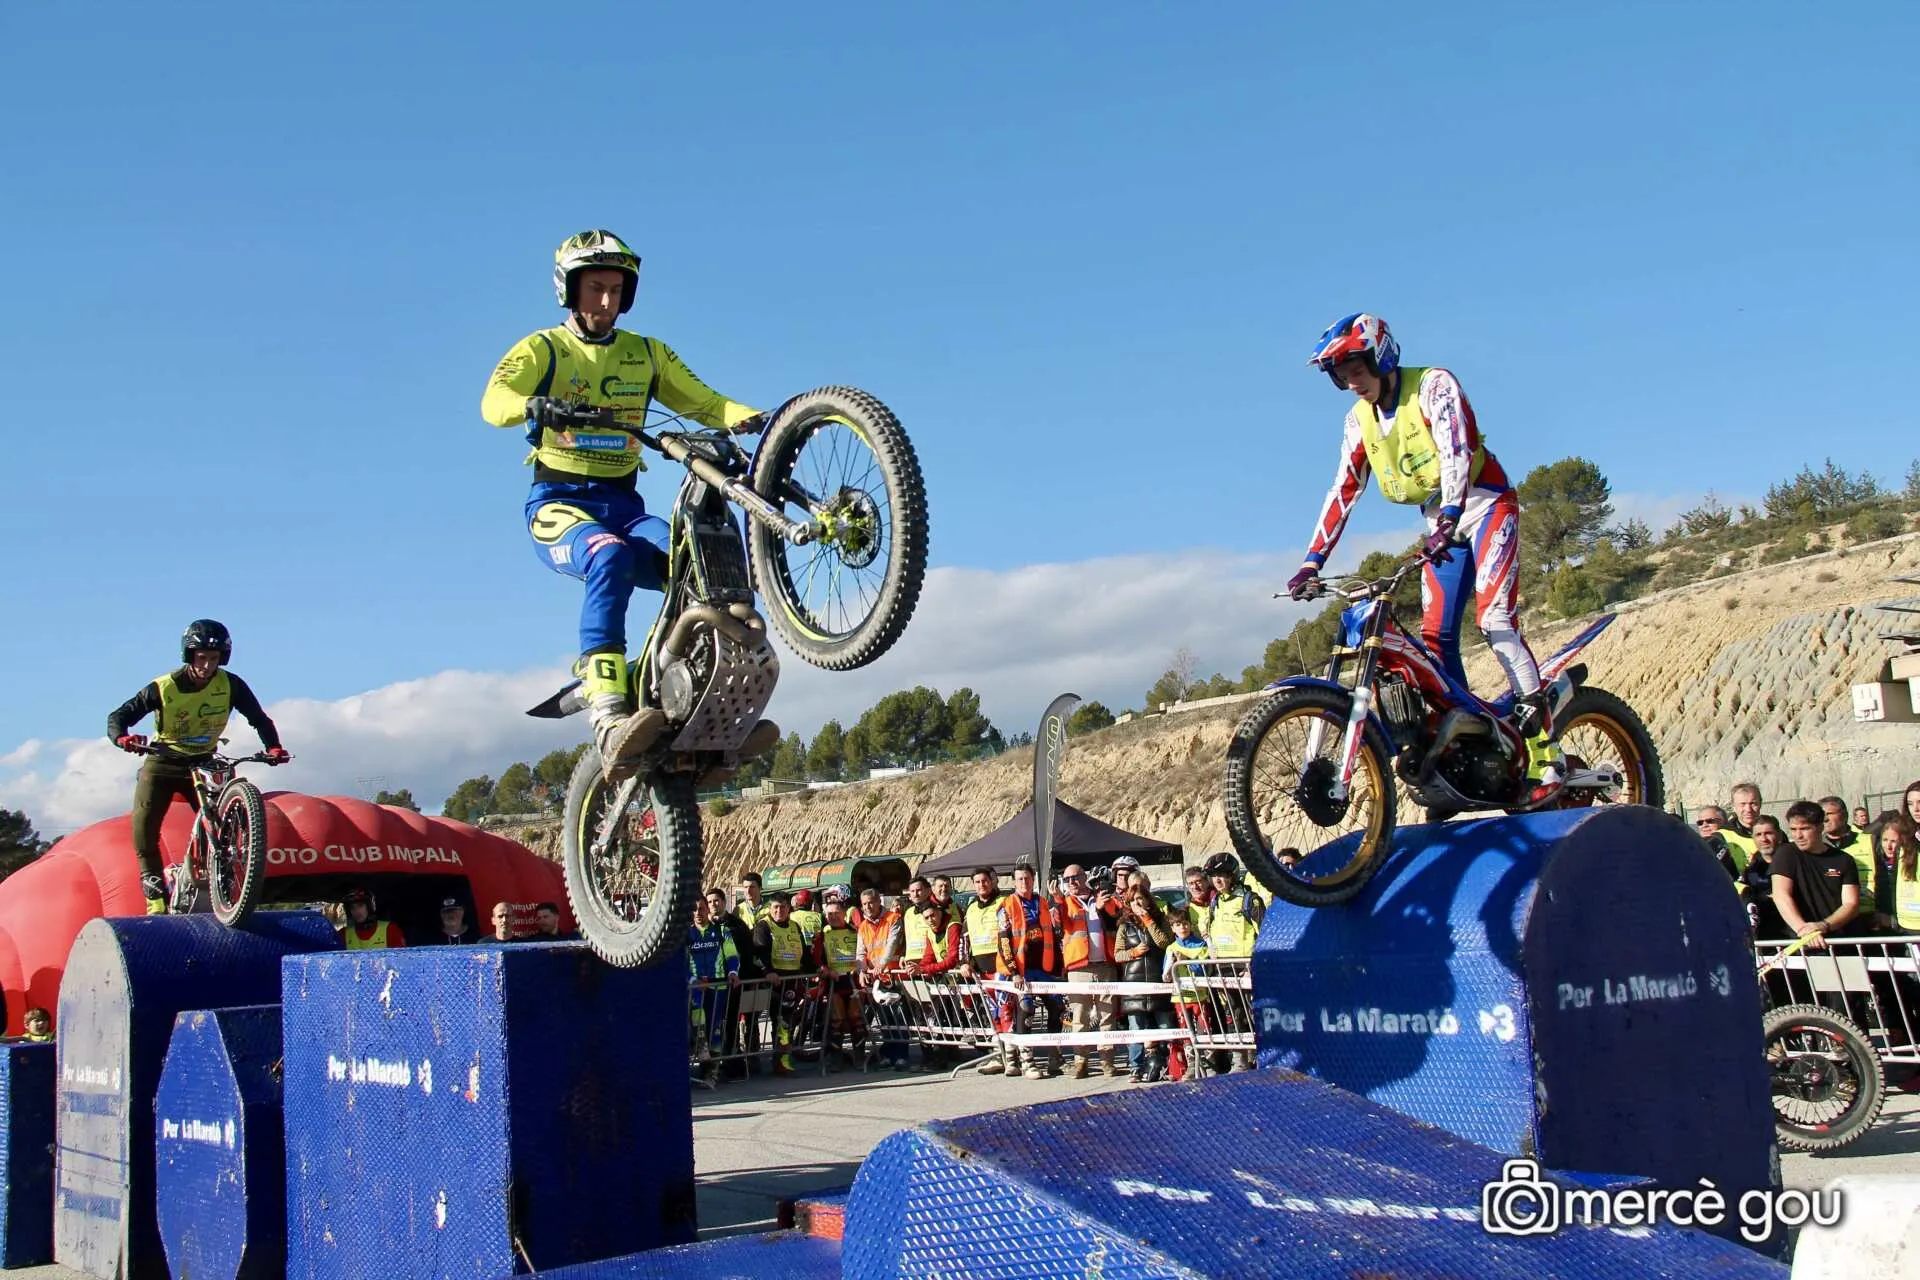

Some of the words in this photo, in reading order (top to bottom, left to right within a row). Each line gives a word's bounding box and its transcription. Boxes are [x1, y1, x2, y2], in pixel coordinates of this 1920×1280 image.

[266, 847, 318, 865] OTO
[323, 844, 384, 863] CLUB
[387, 844, 463, 867] IMPALA
[1603, 977, 1628, 1005] La
[1262, 1006, 1306, 1033] Per
[1319, 1005, 1352, 1034] La
[1356, 1004, 1461, 1036] Marató
[327, 1054, 347, 1083] Per
[162, 1118, 179, 1140] Per
